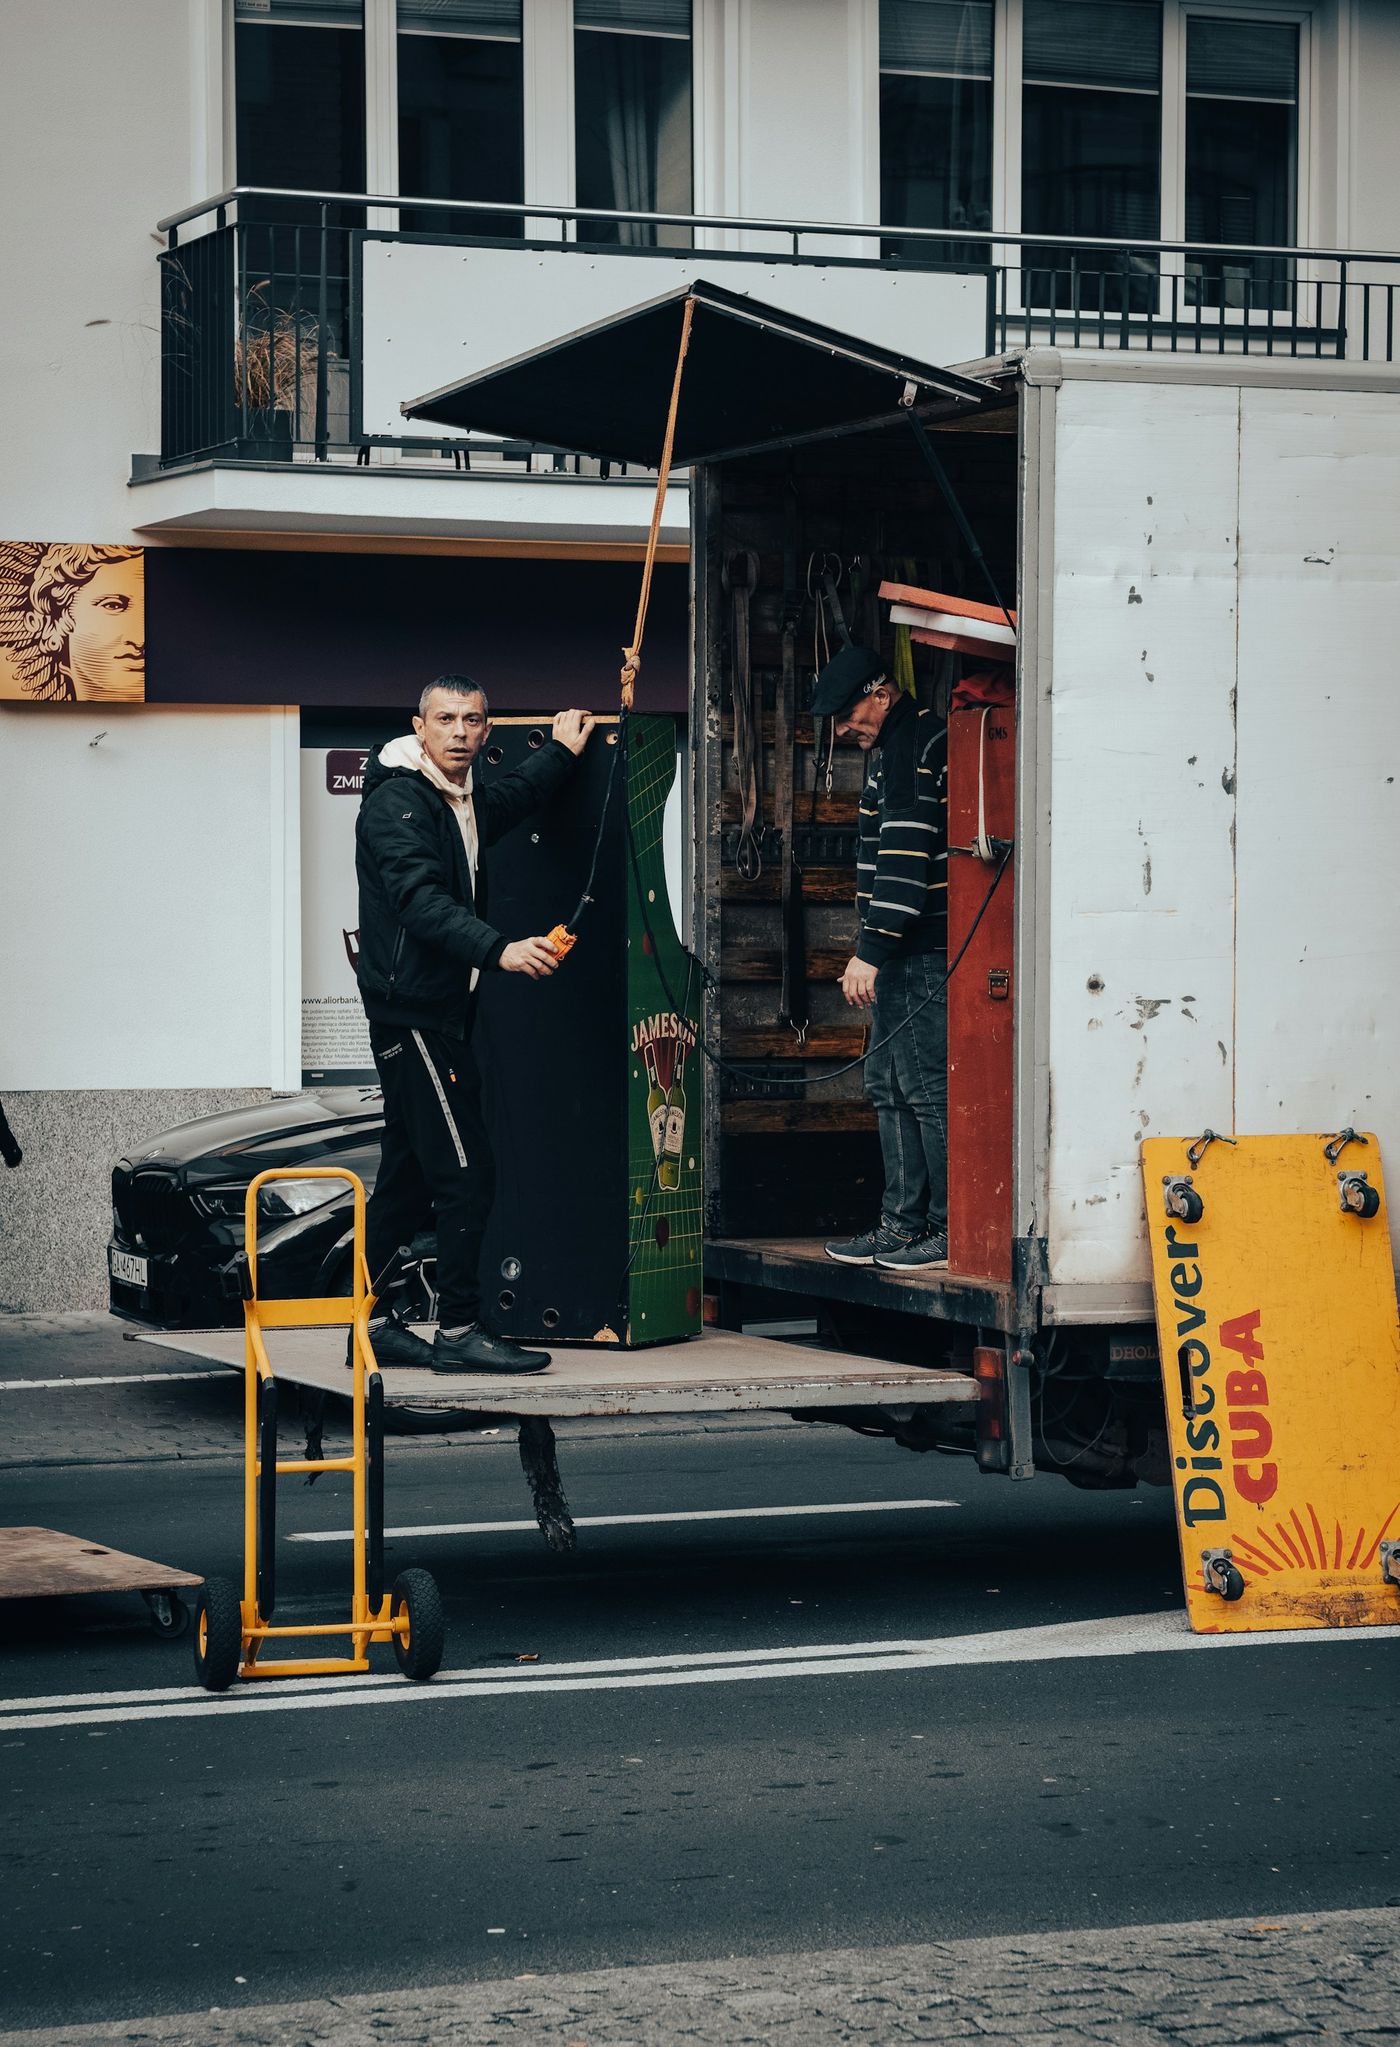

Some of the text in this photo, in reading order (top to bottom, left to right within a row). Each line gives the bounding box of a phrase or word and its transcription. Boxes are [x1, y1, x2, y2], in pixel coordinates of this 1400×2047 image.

[988, 727, 1008, 740] GMS
[631, 1012, 698, 1052] JAMESON
[1164, 1224, 1226, 1528] Discover
[1219, 1308, 1278, 1504] CUBA
